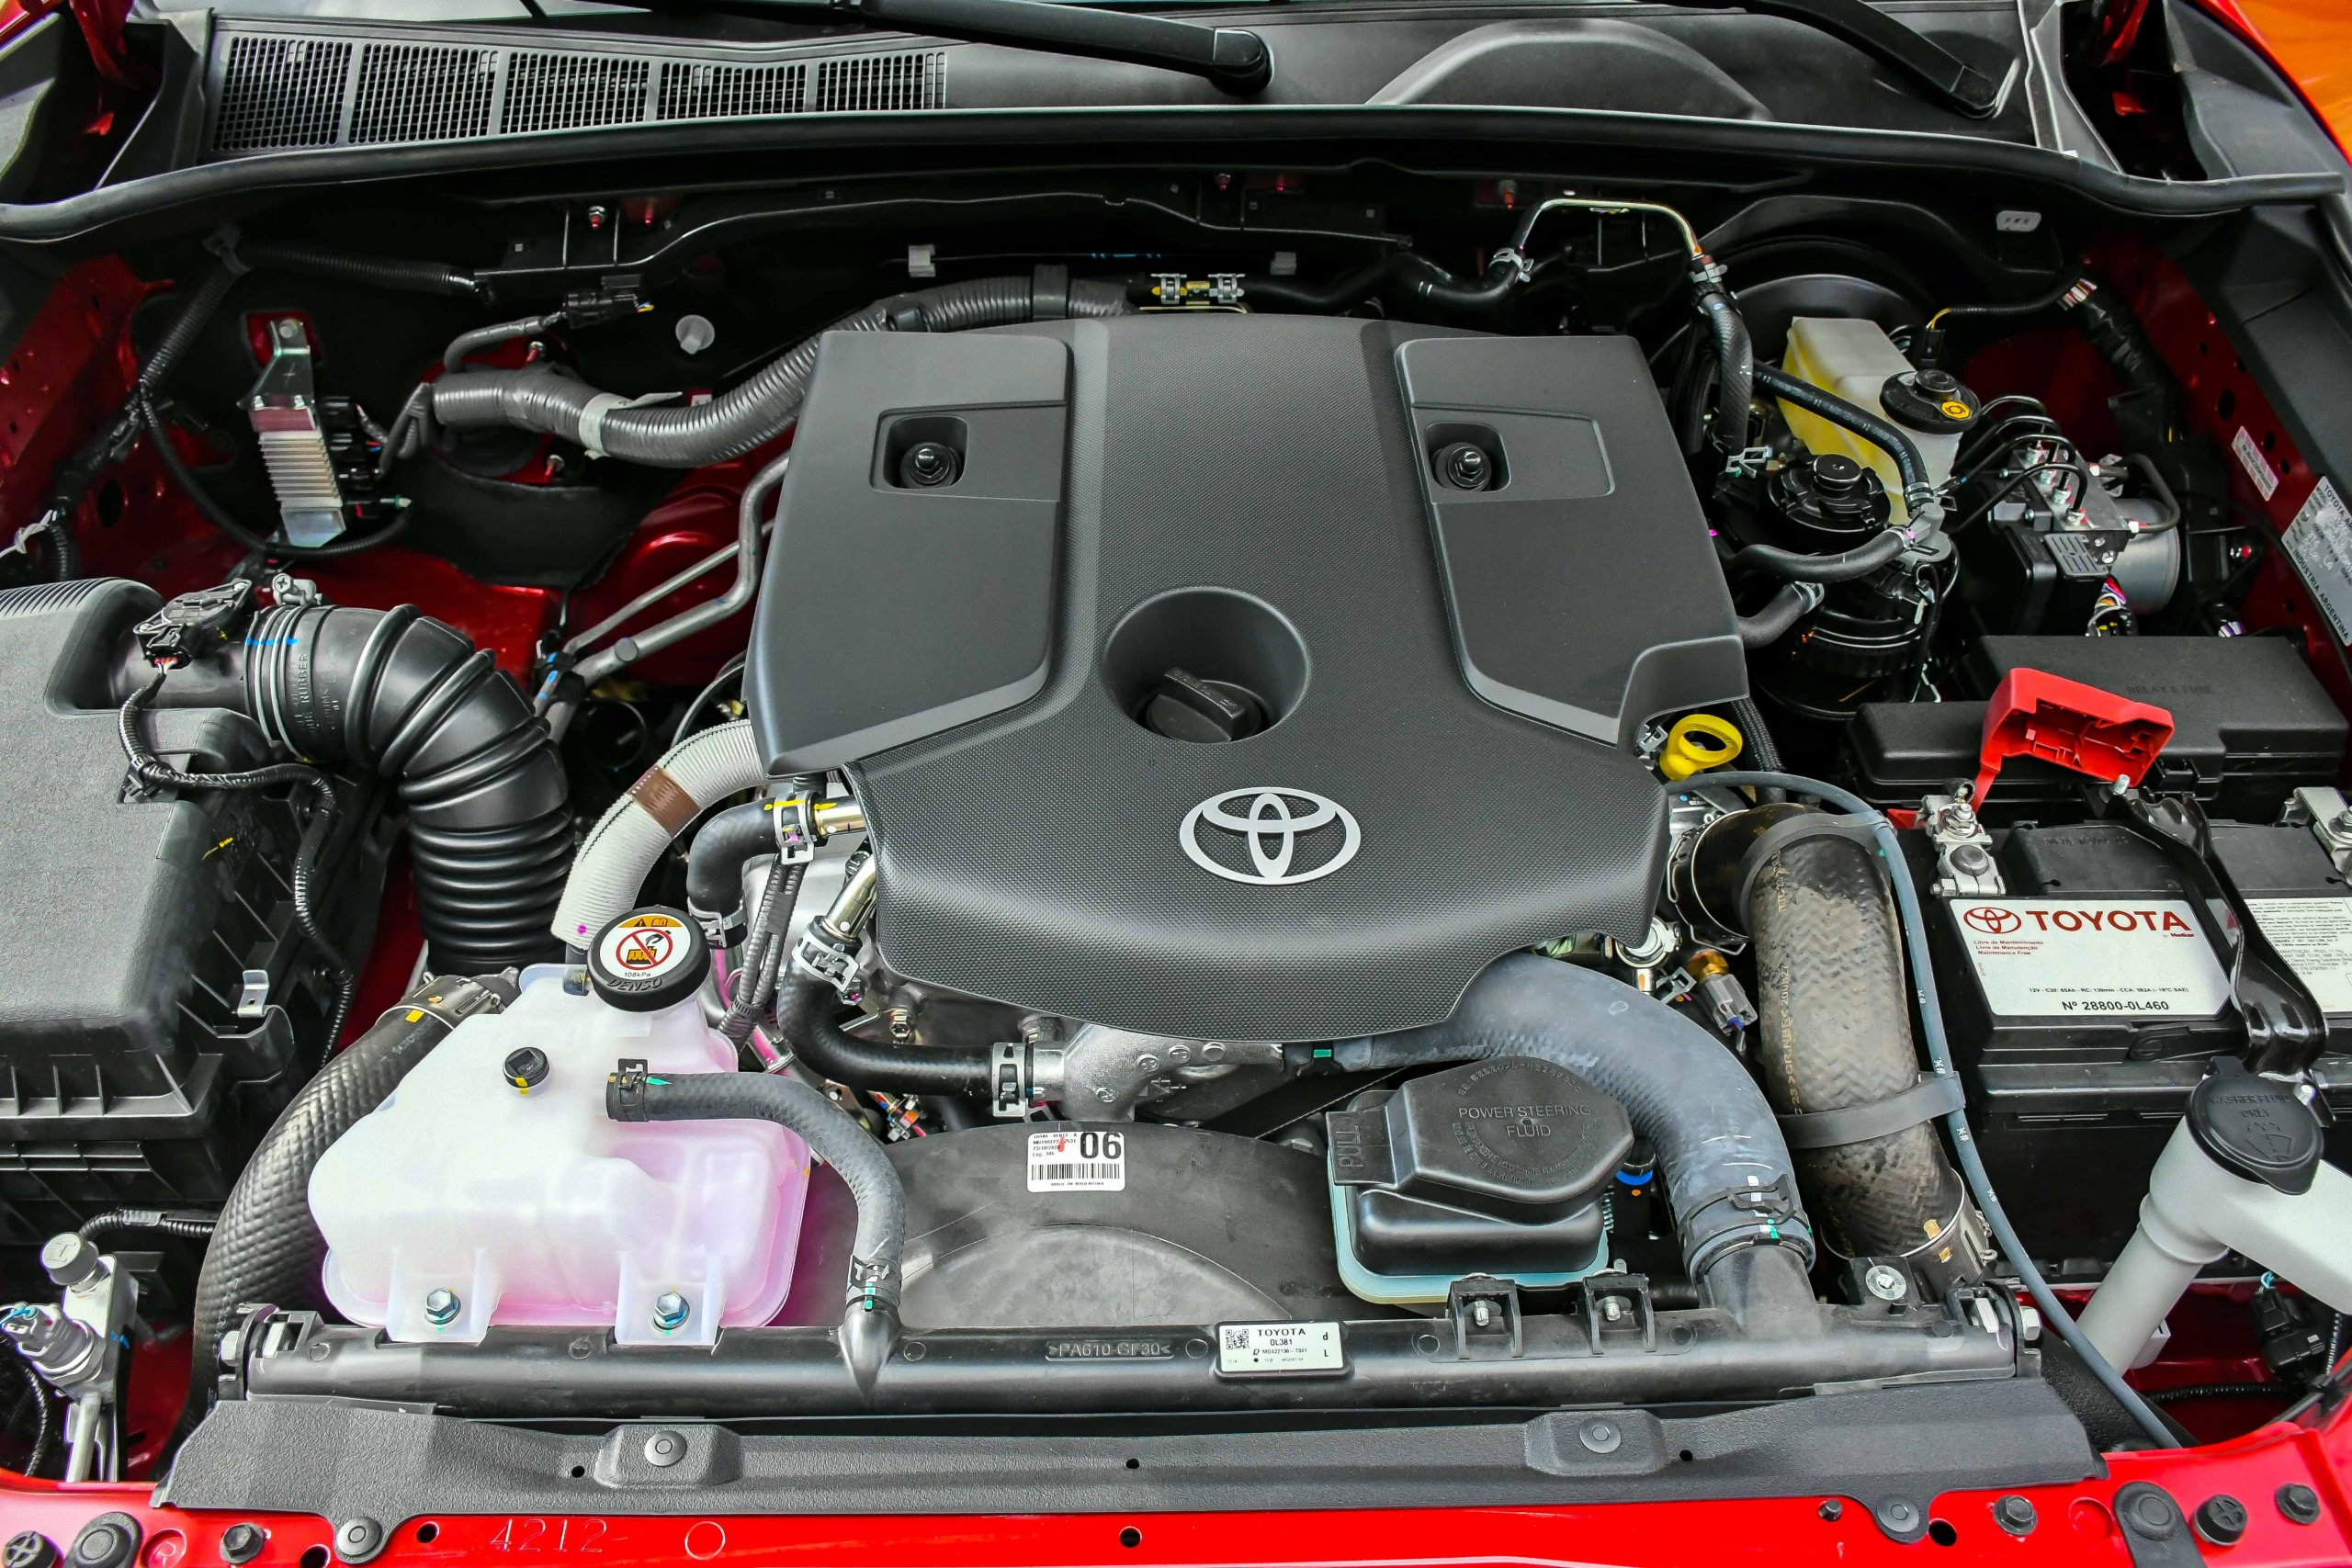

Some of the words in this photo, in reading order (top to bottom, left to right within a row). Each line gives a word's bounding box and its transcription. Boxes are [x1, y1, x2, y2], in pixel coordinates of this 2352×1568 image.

[2324, 485, 2346, 517] TOYOTA
[2293, 549, 2320, 592] INDUSTRIA
[2319, 593, 2349, 639] ARGENTINA
[2026, 910, 2192, 931] TOYOTA
[606, 978, 662, 991] DENSO
[2082, 1001, 2169, 1010] 28800-0L460
[1459, 1107, 1514, 1119] POWER
[1517, 1105, 1591, 1117] STEERING
[1506, 1125, 1551, 1138] FLUID
[1080, 1132, 1122, 1159] 06
[1336, 1124, 1363, 1168] PULL
